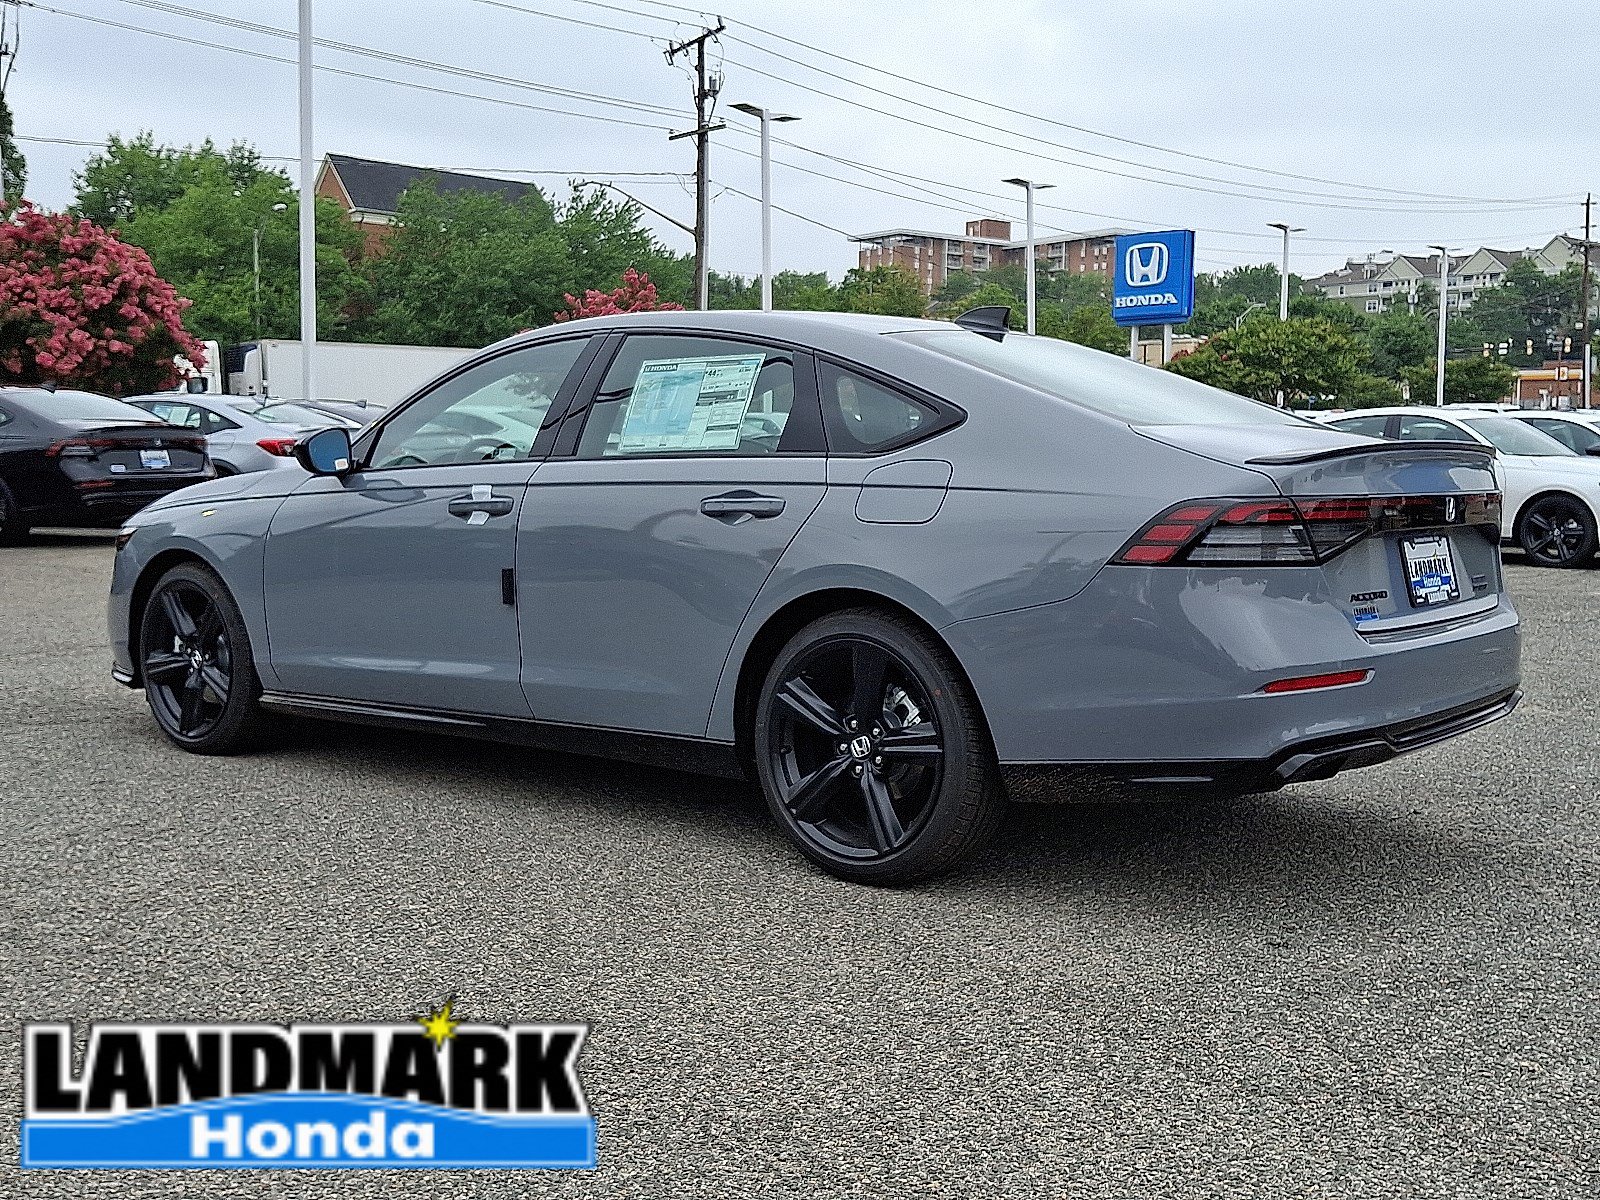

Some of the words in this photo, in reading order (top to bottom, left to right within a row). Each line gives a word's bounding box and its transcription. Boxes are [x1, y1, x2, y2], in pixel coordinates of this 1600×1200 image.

[1114, 293, 1178, 308] HONDA
[1408, 556, 1450, 579] LANDMARK
[1422, 575, 1442, 588] Honda
